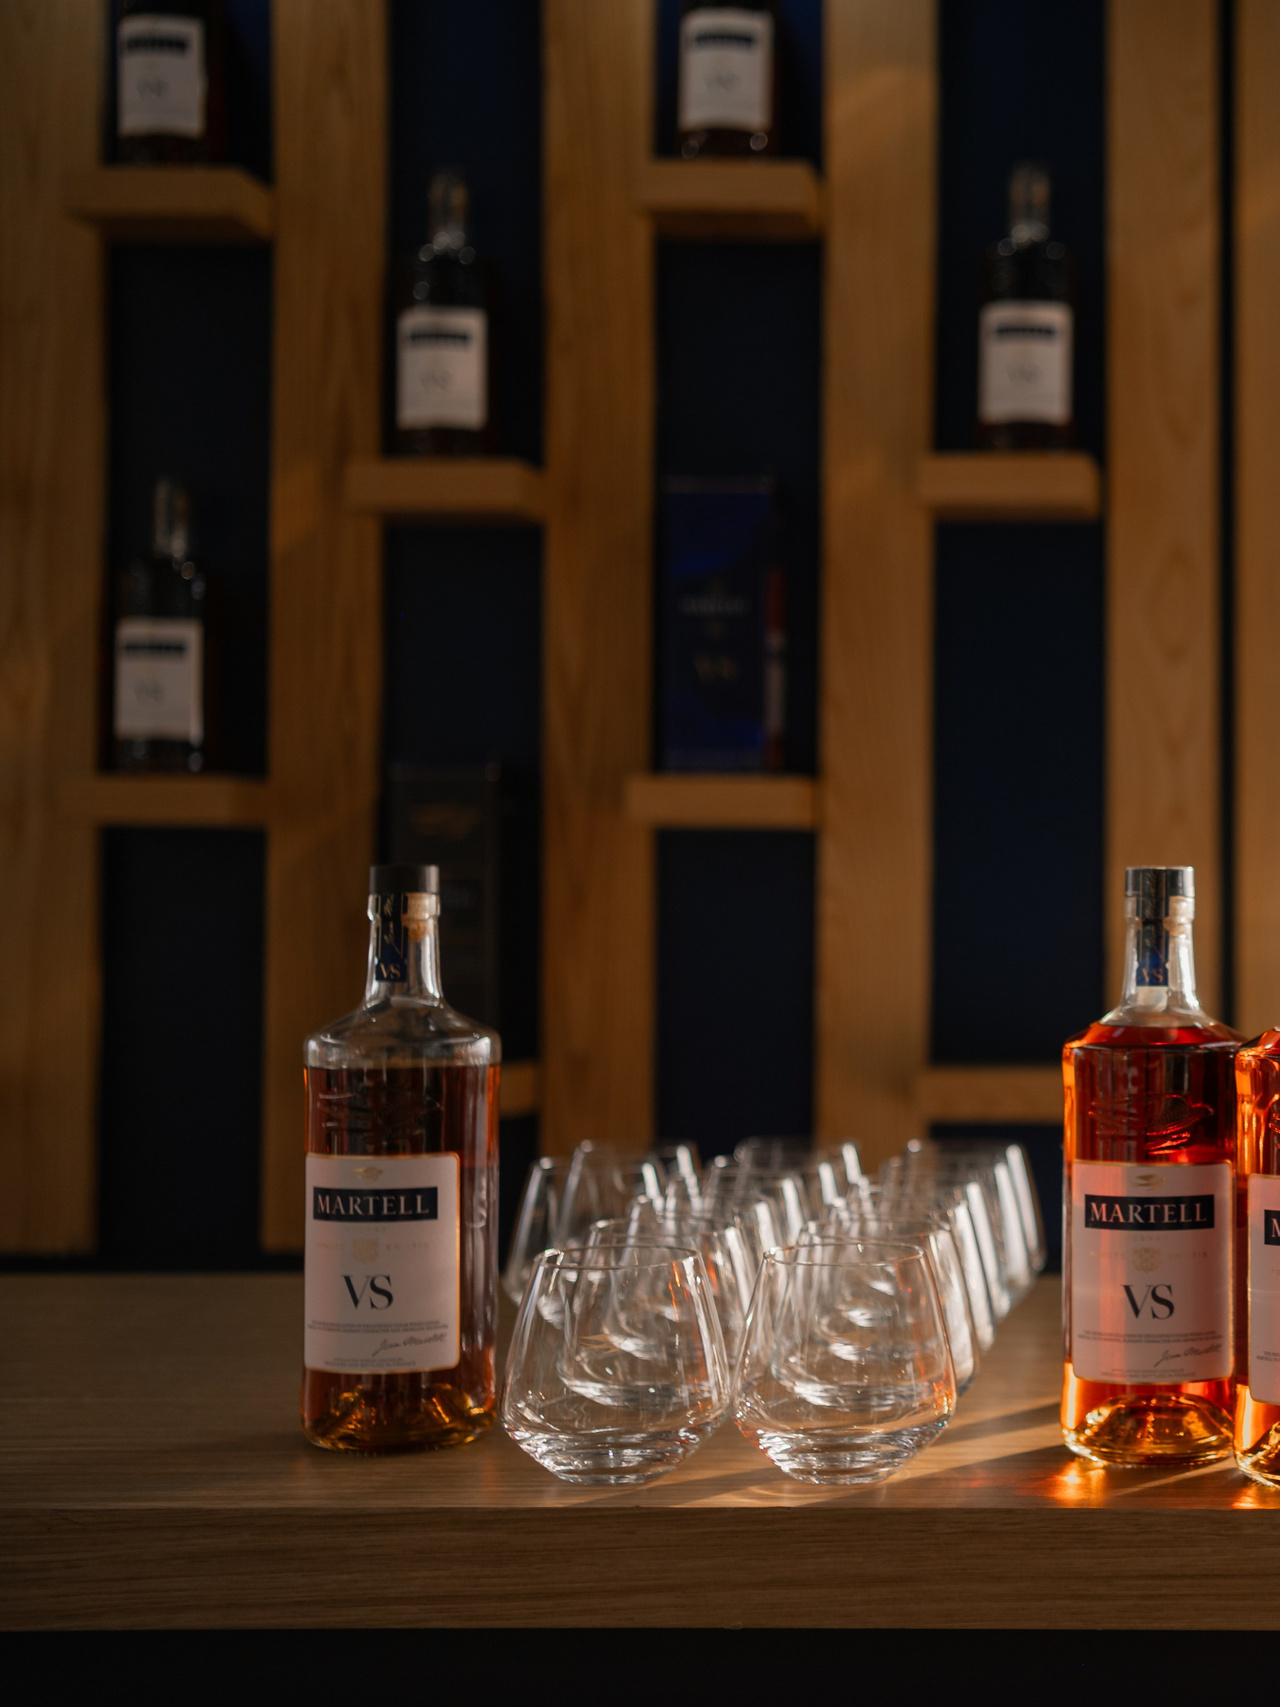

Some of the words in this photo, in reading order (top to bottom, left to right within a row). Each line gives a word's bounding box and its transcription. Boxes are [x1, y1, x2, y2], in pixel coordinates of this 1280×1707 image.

[380, 962, 401, 980] VS
[1141, 967, 1164, 985] VS
[317, 1194, 430, 1216] MARTELL
[1090, 1202, 1207, 1224] MARTELL
[341, 1274, 394, 1311] VS
[1121, 1284, 1175, 1320] VS
